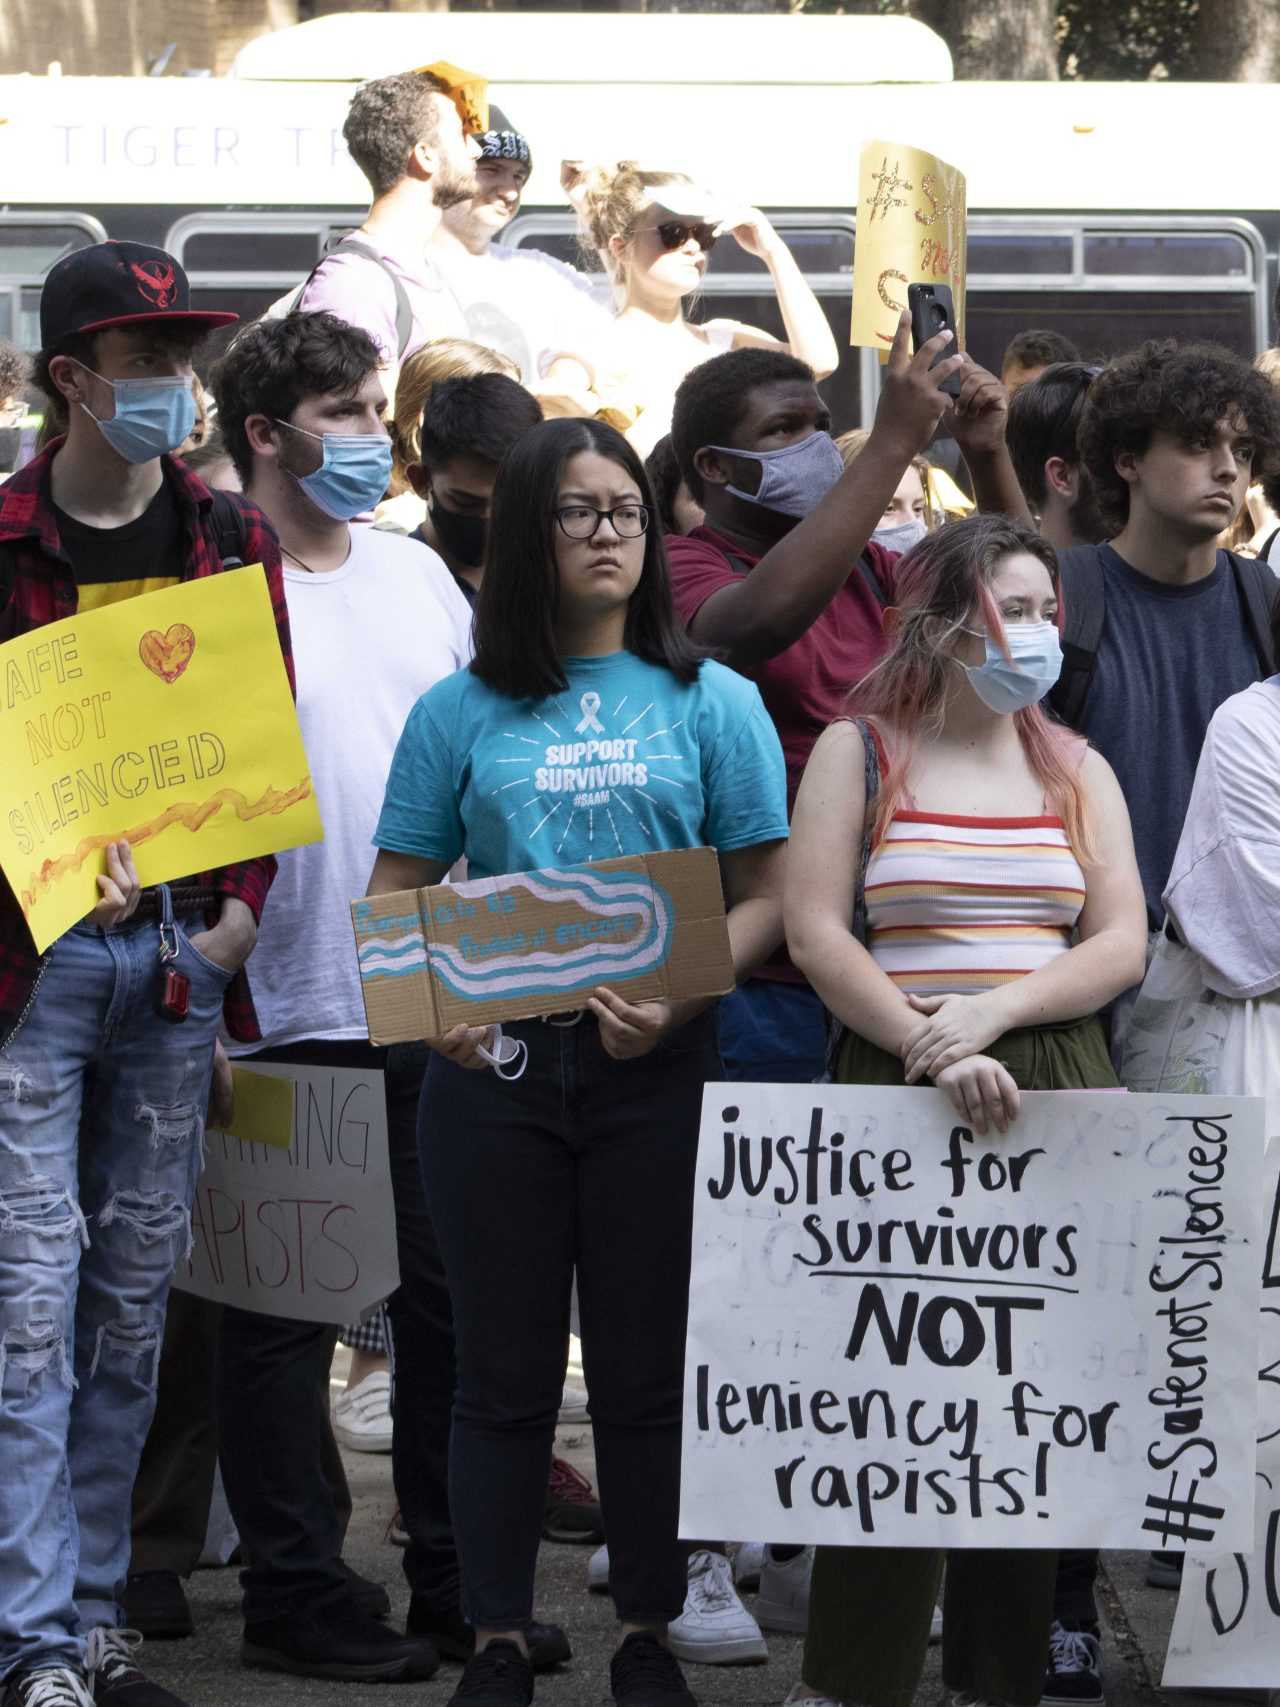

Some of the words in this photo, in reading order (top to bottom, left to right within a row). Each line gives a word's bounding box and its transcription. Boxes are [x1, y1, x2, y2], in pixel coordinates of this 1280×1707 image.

[52, 123, 240, 168] TIGER
[6, 632, 83, 709] AFE
[24, 691, 112, 766] NOT
[545, 738, 638, 766] SUPPORT
[8, 732, 226, 855] SILENCED
[535, 762, 648, 792] SURVIVORS
[707, 1106, 912, 1205] justice
[940, 1126, 1047, 1197] for
[188, 1186, 359, 1294] APISTS
[793, 1206, 1078, 1277] survivors
[844, 1283, 1045, 1375] NOT
[697, 1364, 979, 1460] leniency
[1003, 1381, 1120, 1452] for
[774, 1442, 1050, 1532] rapists!
